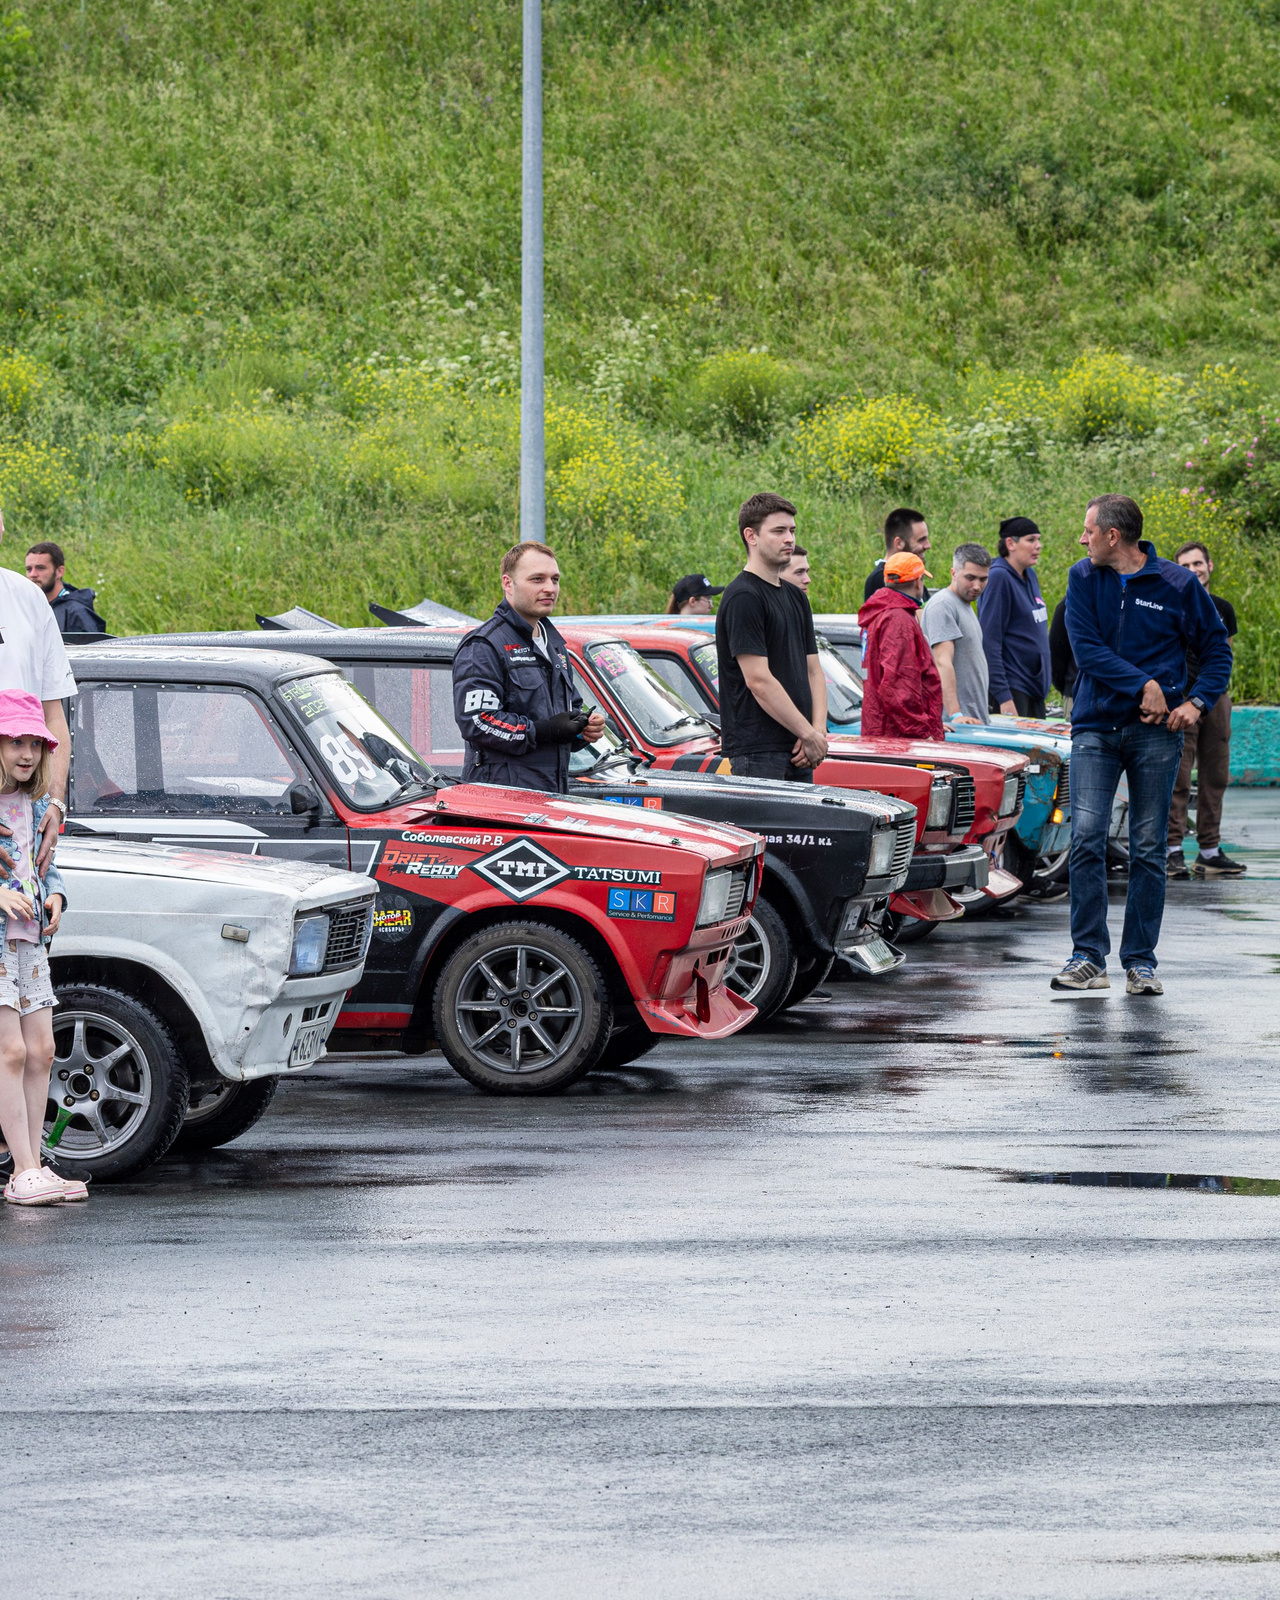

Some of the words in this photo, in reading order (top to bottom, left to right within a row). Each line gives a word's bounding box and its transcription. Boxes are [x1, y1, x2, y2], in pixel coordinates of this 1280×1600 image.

[1135, 598, 1163, 611] StarLine
[464, 689, 500, 713] 85
[320, 733, 377, 785] 85
[401, 830, 481, 845] Соболевский
[481, 834, 506, 846] Р.В.
[786, 834, 815, 846] 34/1
[381, 849, 440, 865] DRIFT
[405, 862, 466, 875] READY
[497, 860, 548, 878] TMI
[574, 867, 662, 884] TATSUMI
[613, 891, 670, 912] SKR
[608, 910, 630, 918] Service
